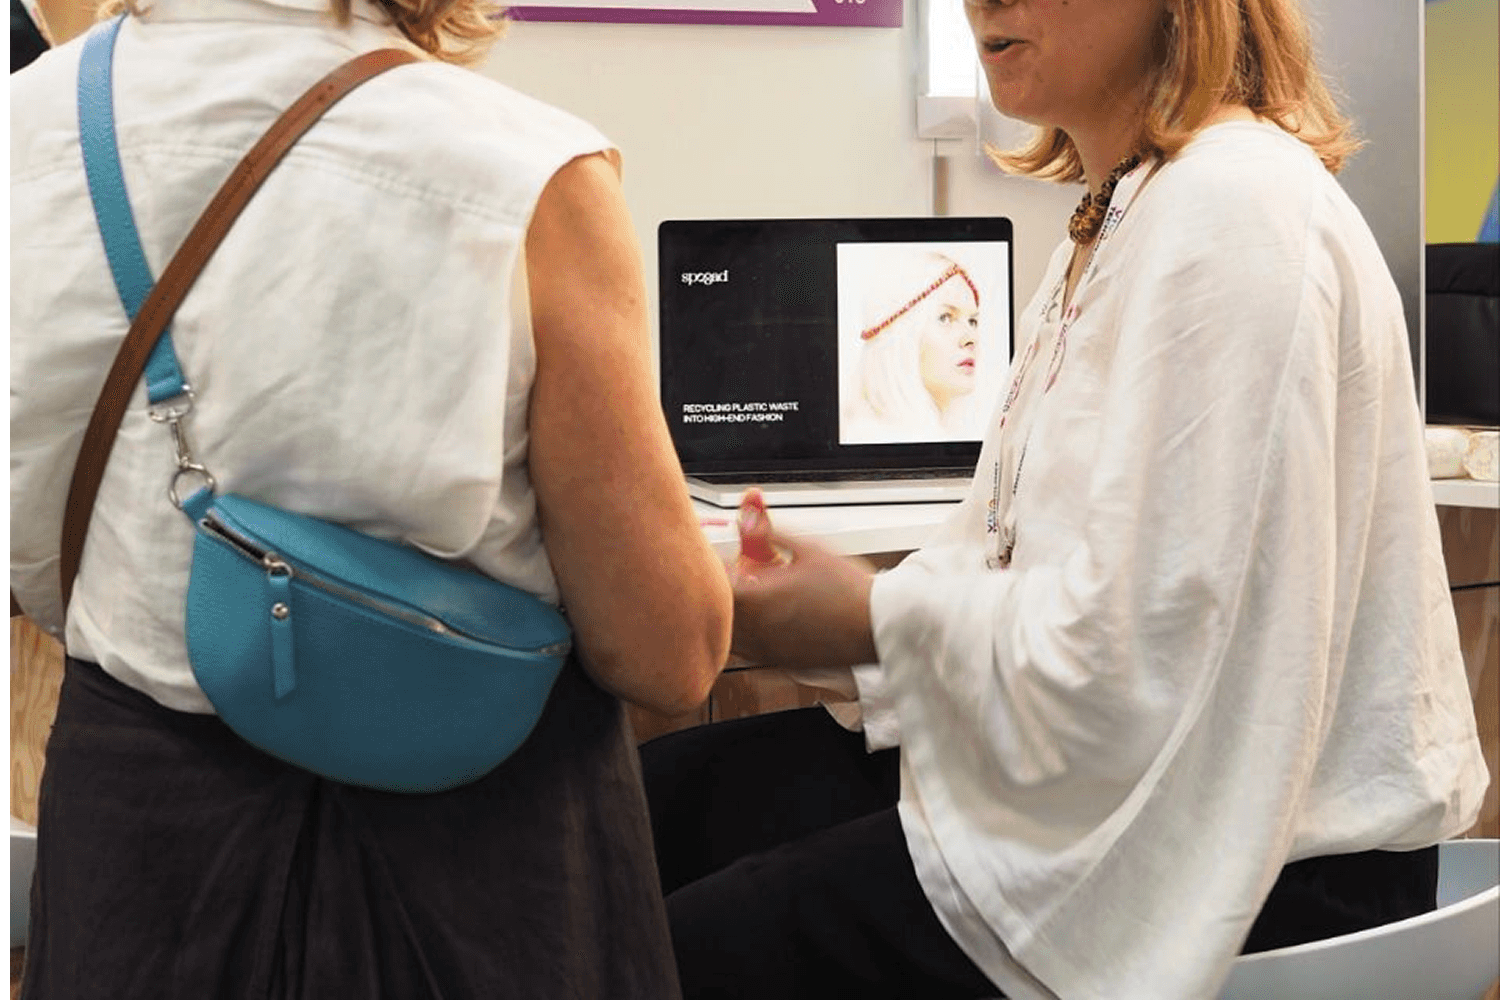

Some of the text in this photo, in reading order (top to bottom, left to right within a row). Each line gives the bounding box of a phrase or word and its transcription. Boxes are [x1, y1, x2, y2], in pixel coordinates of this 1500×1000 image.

[681, 269, 730, 286] spogad
[682, 401, 799, 413] RECYCLING PLASTIC WASTE
[682, 412, 784, 423] INTO HIGH-END FASHION
